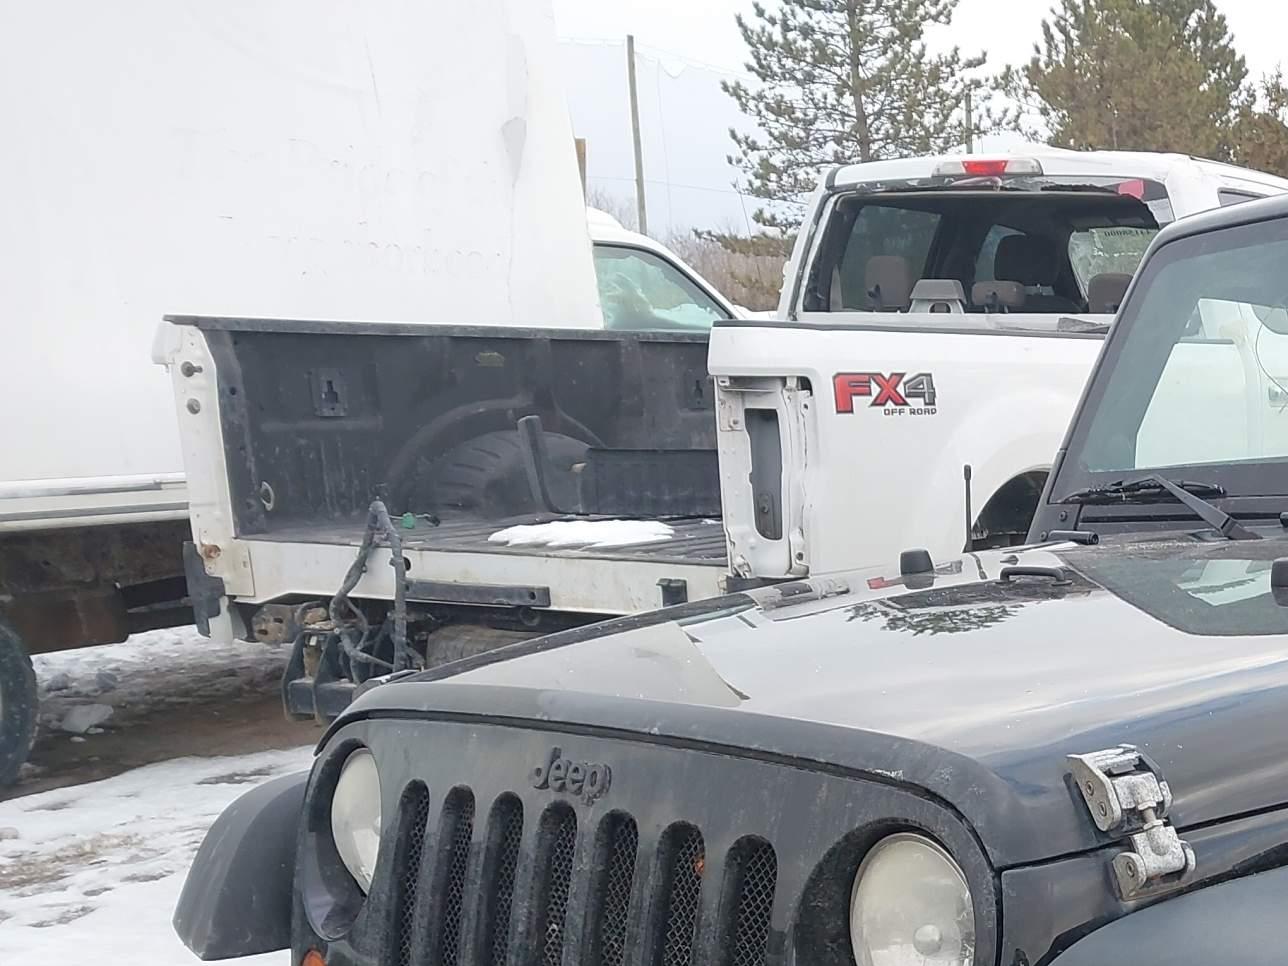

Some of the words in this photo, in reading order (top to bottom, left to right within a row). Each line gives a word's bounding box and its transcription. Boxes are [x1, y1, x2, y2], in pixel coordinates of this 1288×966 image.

[832, 372, 937, 414] FX4
[884, 408, 905, 416] OFF
[909, 408, 937, 416] ROAD
[528, 747, 612, 807] Jeep
